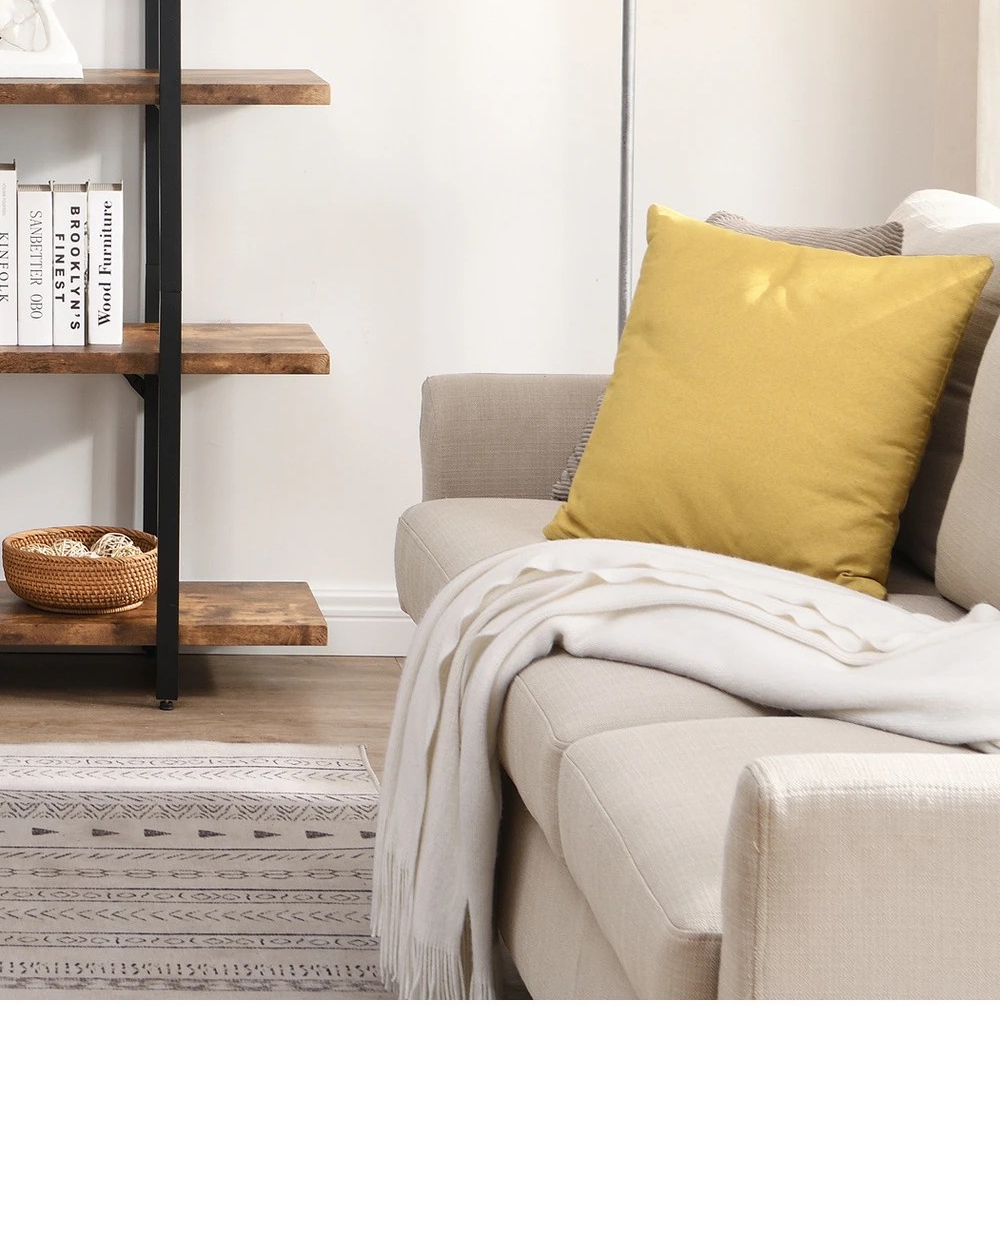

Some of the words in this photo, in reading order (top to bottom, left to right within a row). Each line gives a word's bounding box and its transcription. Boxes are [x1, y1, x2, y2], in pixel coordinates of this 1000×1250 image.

[0, 232, 10, 303] KINFOLK
[30, 210, 43, 286] SANBETTER
[55, 233, 65, 302] FINEST
[70, 206, 81, 330] BROOKLYN'S
[98, 200, 113, 275] Furniture
[30, 293, 43, 320] OBO
[97, 282, 112, 326] Wood
